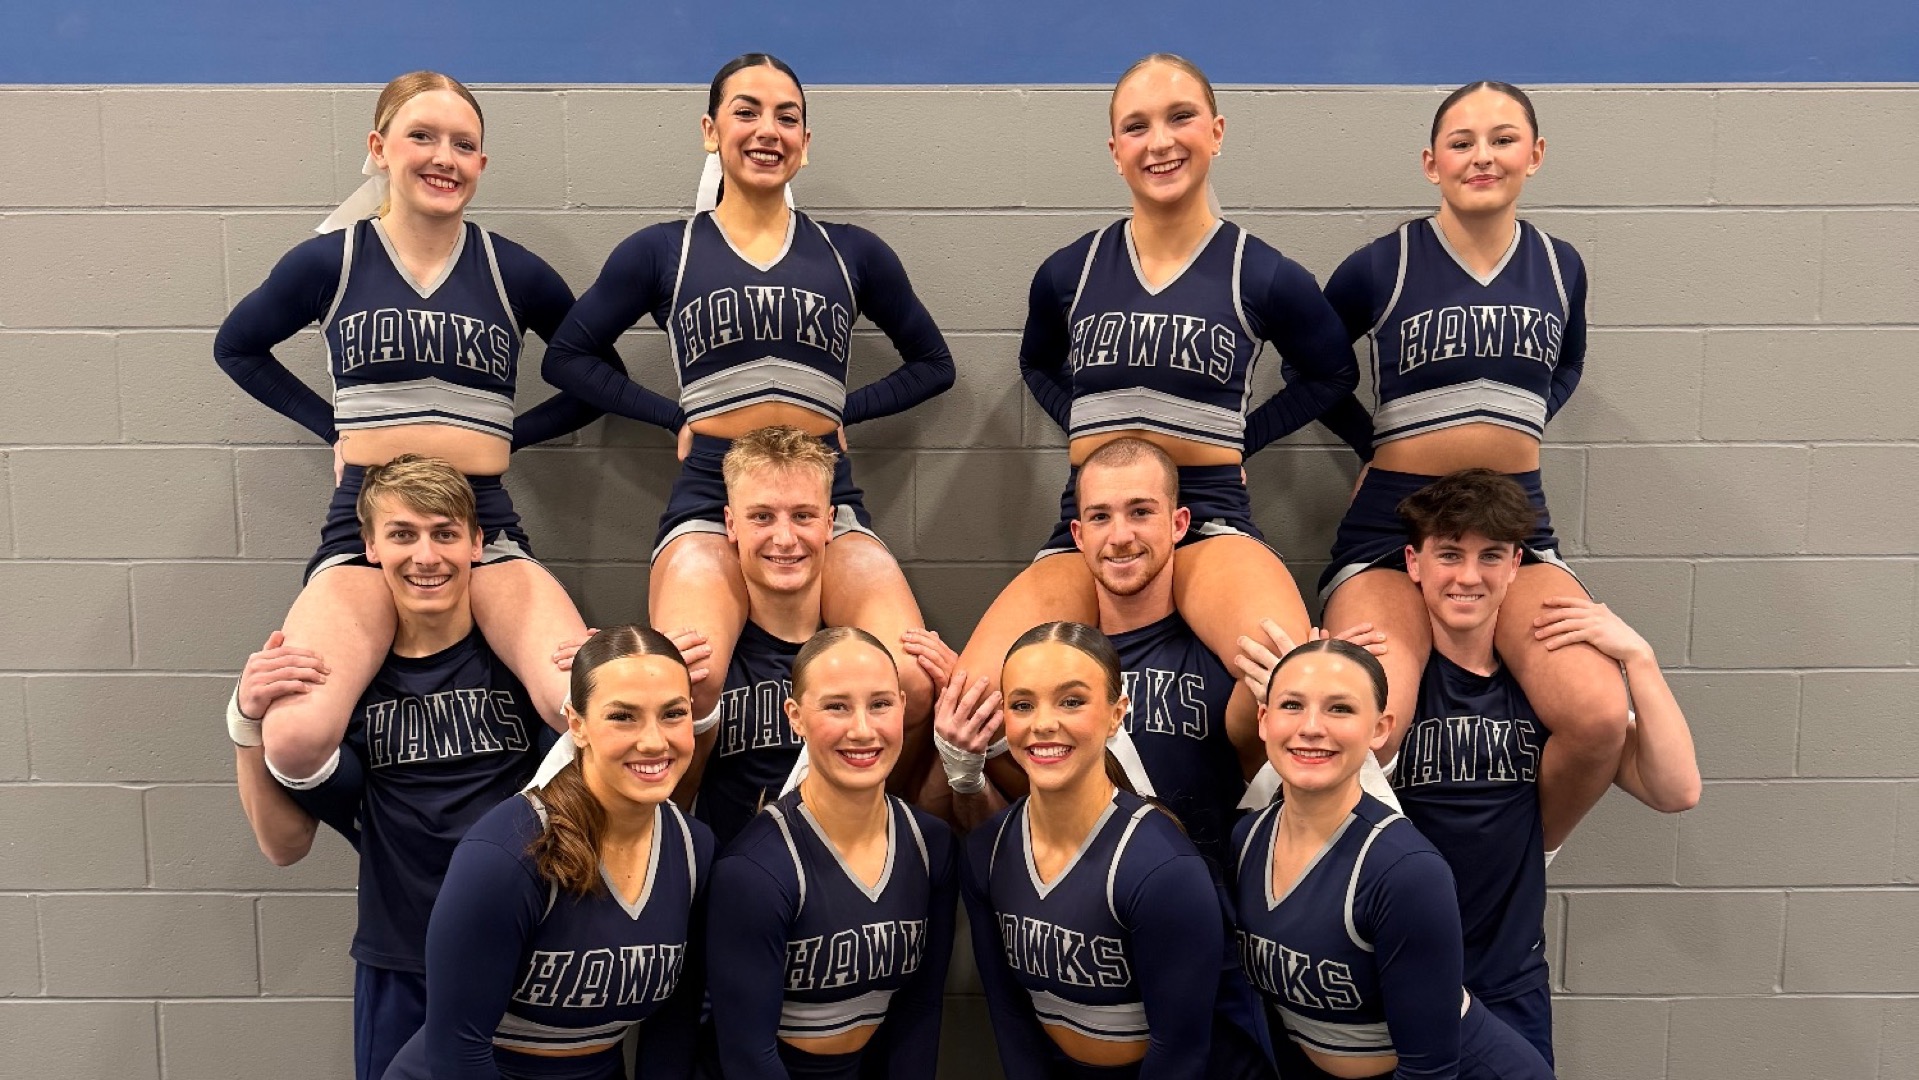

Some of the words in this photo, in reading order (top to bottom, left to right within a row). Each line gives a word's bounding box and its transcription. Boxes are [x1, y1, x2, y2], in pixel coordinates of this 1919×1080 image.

[338, 307, 510, 382] HAWKS
[678, 286, 849, 368] HAWKS
[1071, 311, 1236, 384] HAWKS
[1399, 305, 1562, 375] HAWKS
[366, 688, 531, 769] HAWKS
[995, 912, 1131, 988] AWKS
